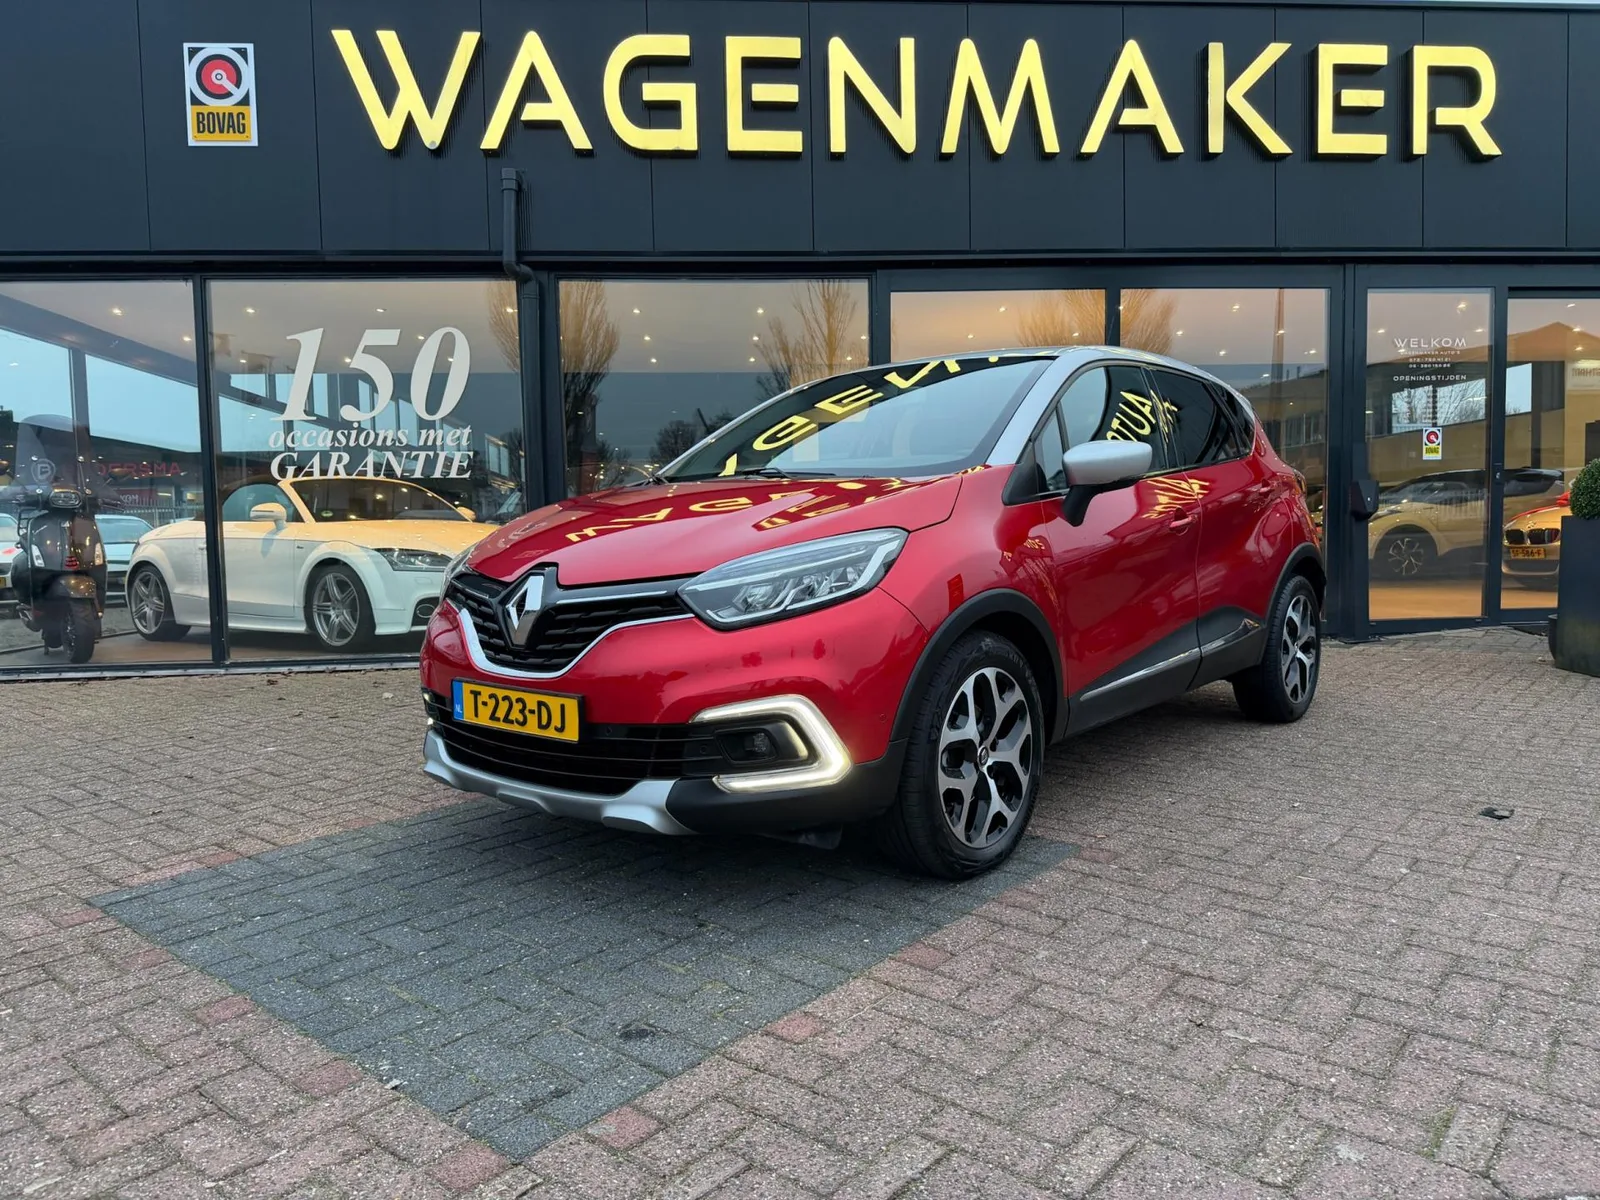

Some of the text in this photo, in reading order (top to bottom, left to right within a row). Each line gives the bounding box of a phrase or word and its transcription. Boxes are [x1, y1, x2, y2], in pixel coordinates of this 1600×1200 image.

[331, 28, 1502, 157] WAGENMAKER
[195, 111, 247, 135] BOVAG
[1393, 337, 1467, 348] WELKOM
[269, 326, 471, 422] 150
[268, 422, 473, 448] occasions met
[270, 450, 474, 481] GARANTIE
[470, 689, 566, 733] T-223-DJ
